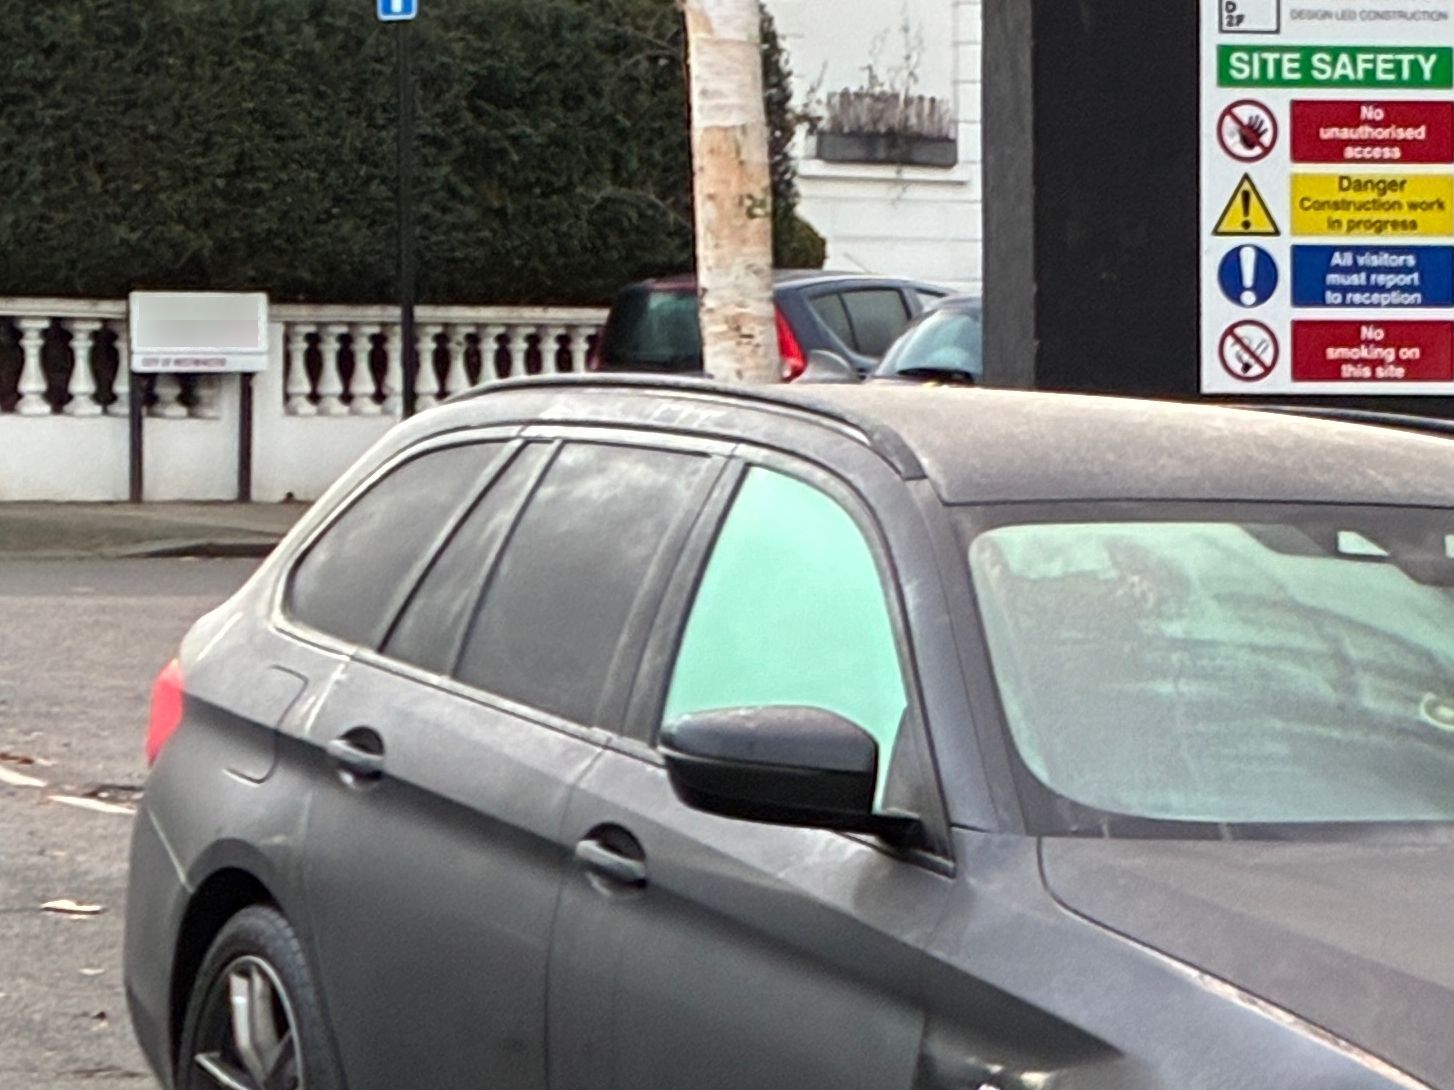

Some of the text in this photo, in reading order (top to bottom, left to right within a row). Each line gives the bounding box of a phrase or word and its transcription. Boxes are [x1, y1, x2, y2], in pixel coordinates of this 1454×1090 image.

[1289, 9, 1449, 21] DESIGN LED CONSTRUCTION
[1228, 52, 1438, 81] SITE SAFETY
[1360, 105, 1384, 120] No
[1319, 125, 1426, 140] unauthorised
[1344, 146, 1402, 159] access
[1338, 176, 1407, 196] Danger
[1300, 196, 1446, 211] Construction work
[1327, 216, 1418, 233] in progress
[1330, 252, 1416, 267] All visitors
[1325, 272, 1420, 289] must report
[1325, 290, 1422, 307] to reception
[1360, 325, 1384, 341] No
[1325, 344, 1420, 363] smoking on
[1340, 365, 1405, 379] this site
